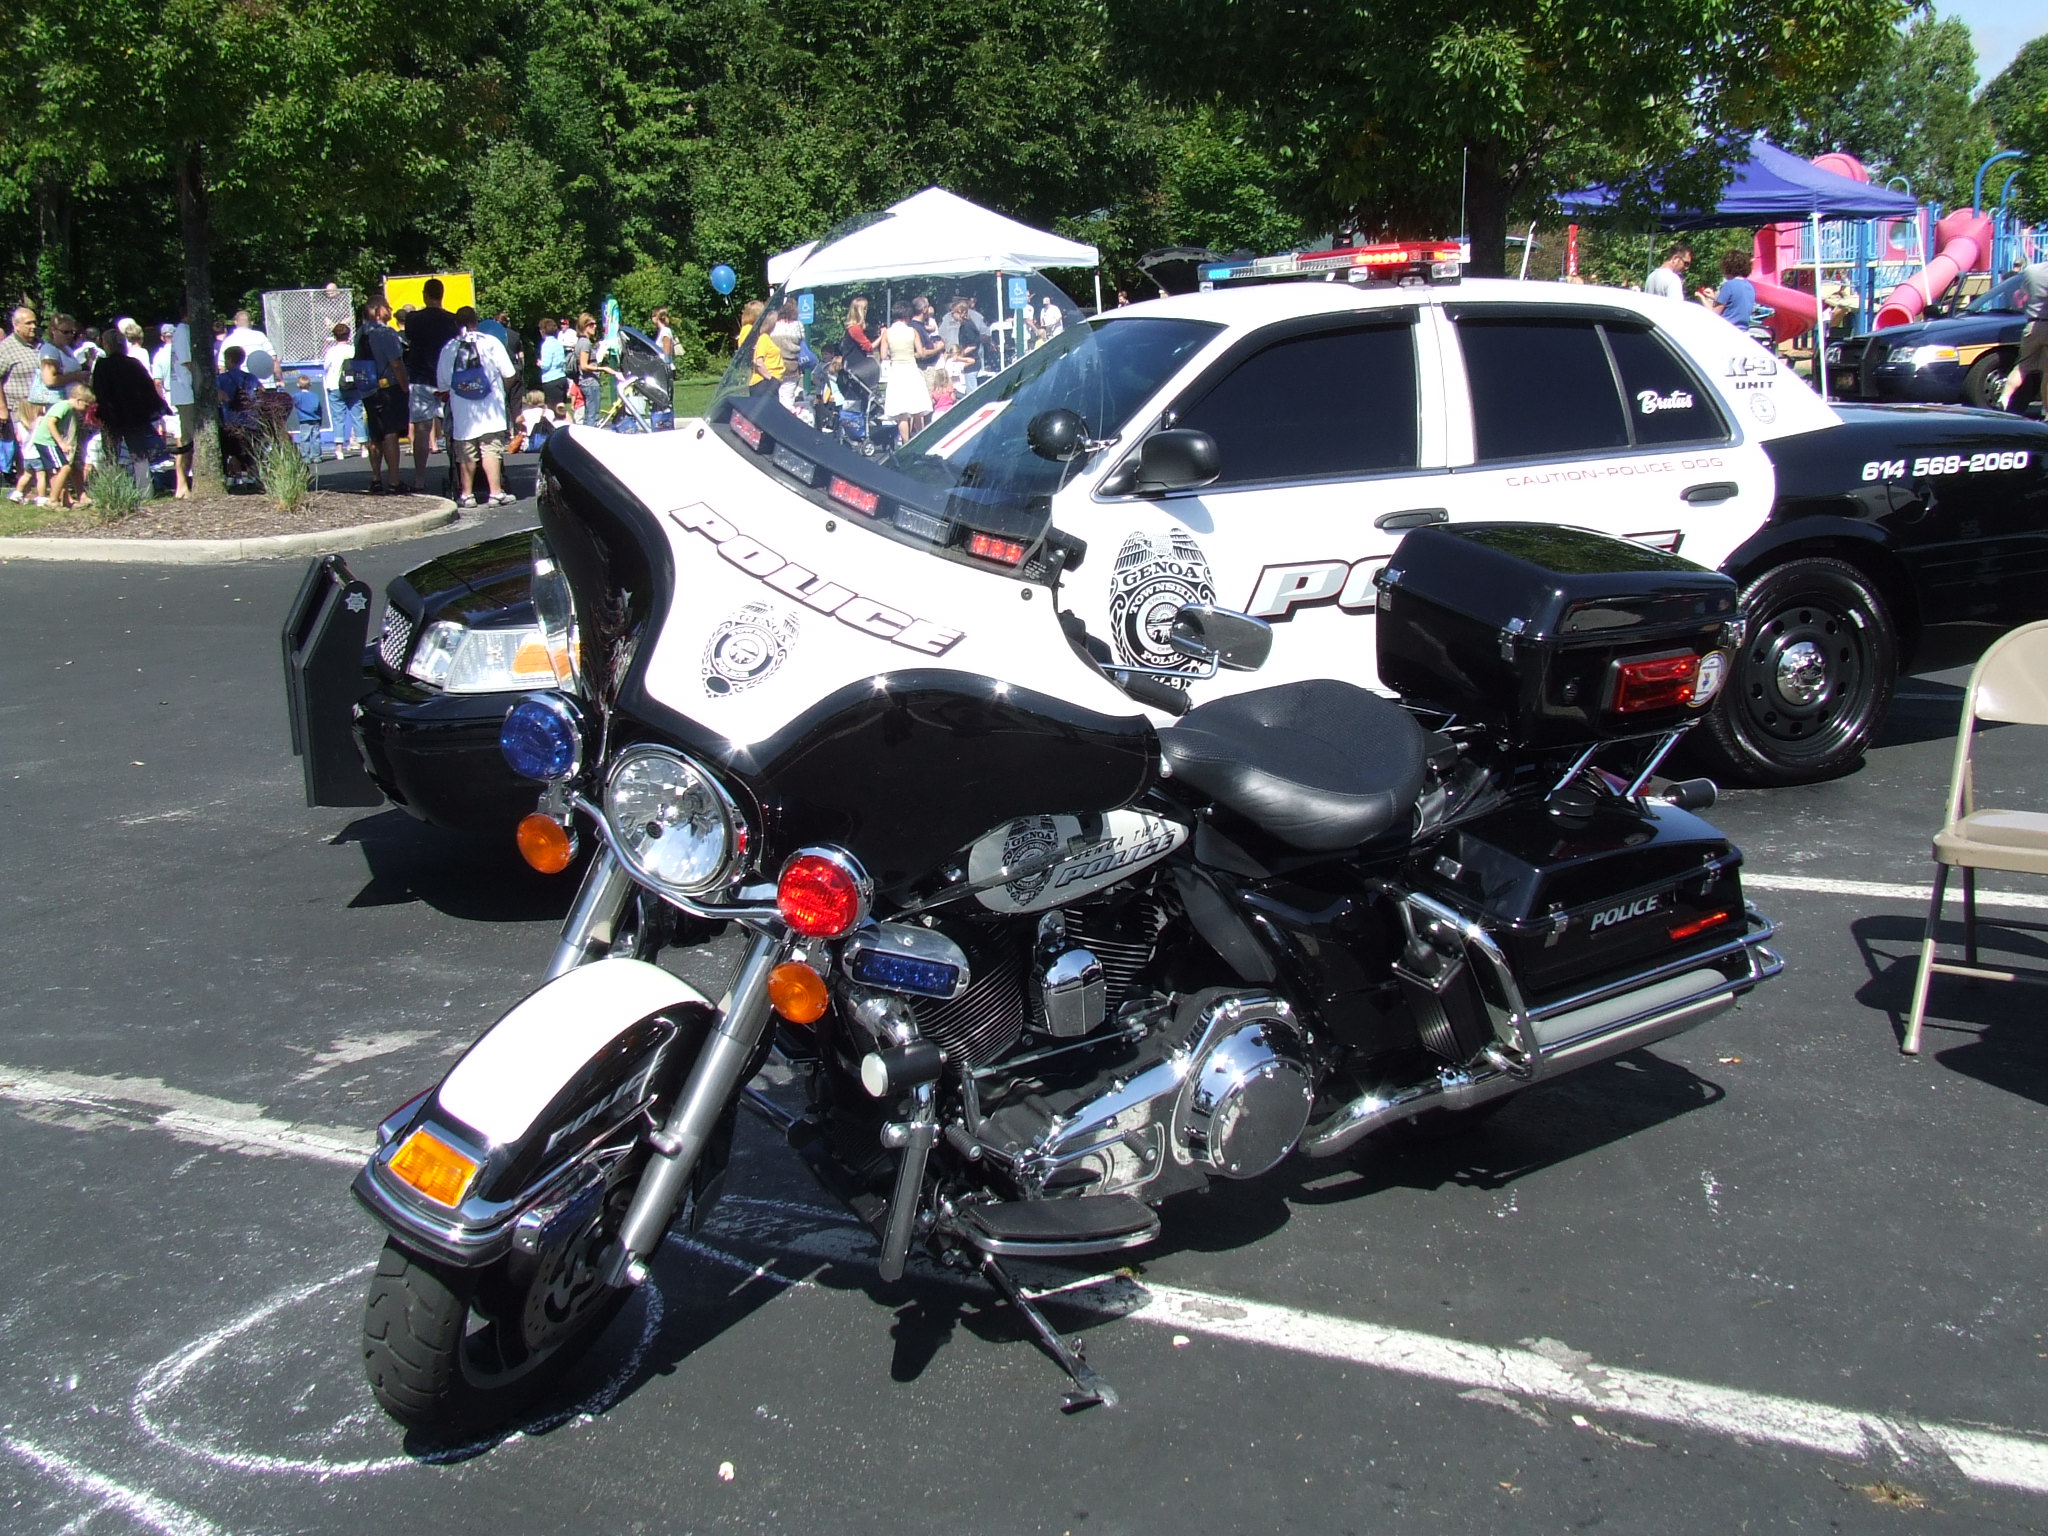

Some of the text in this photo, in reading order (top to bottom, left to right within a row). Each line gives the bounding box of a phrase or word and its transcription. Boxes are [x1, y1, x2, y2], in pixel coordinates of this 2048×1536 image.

[1725, 356, 1777, 377] K-9
[1735, 381, 1774, 390] UNIT
[1637, 390, 1694, 414] Brutus
[1682, 456, 1724, 470] DOG
[1861, 450, 2029, 482] 614 568-2060
[668, 500, 967, 658] POLICE
[1122, 561, 1200, 587] GENOA
[1140, 650, 1184, 665] POLIC
[1012, 831, 1053, 848] GENOA
[1134, 822, 1159, 841] TWP
[1055, 829, 1176, 888] POLICE
[1590, 894, 1659, 931] POLICE
